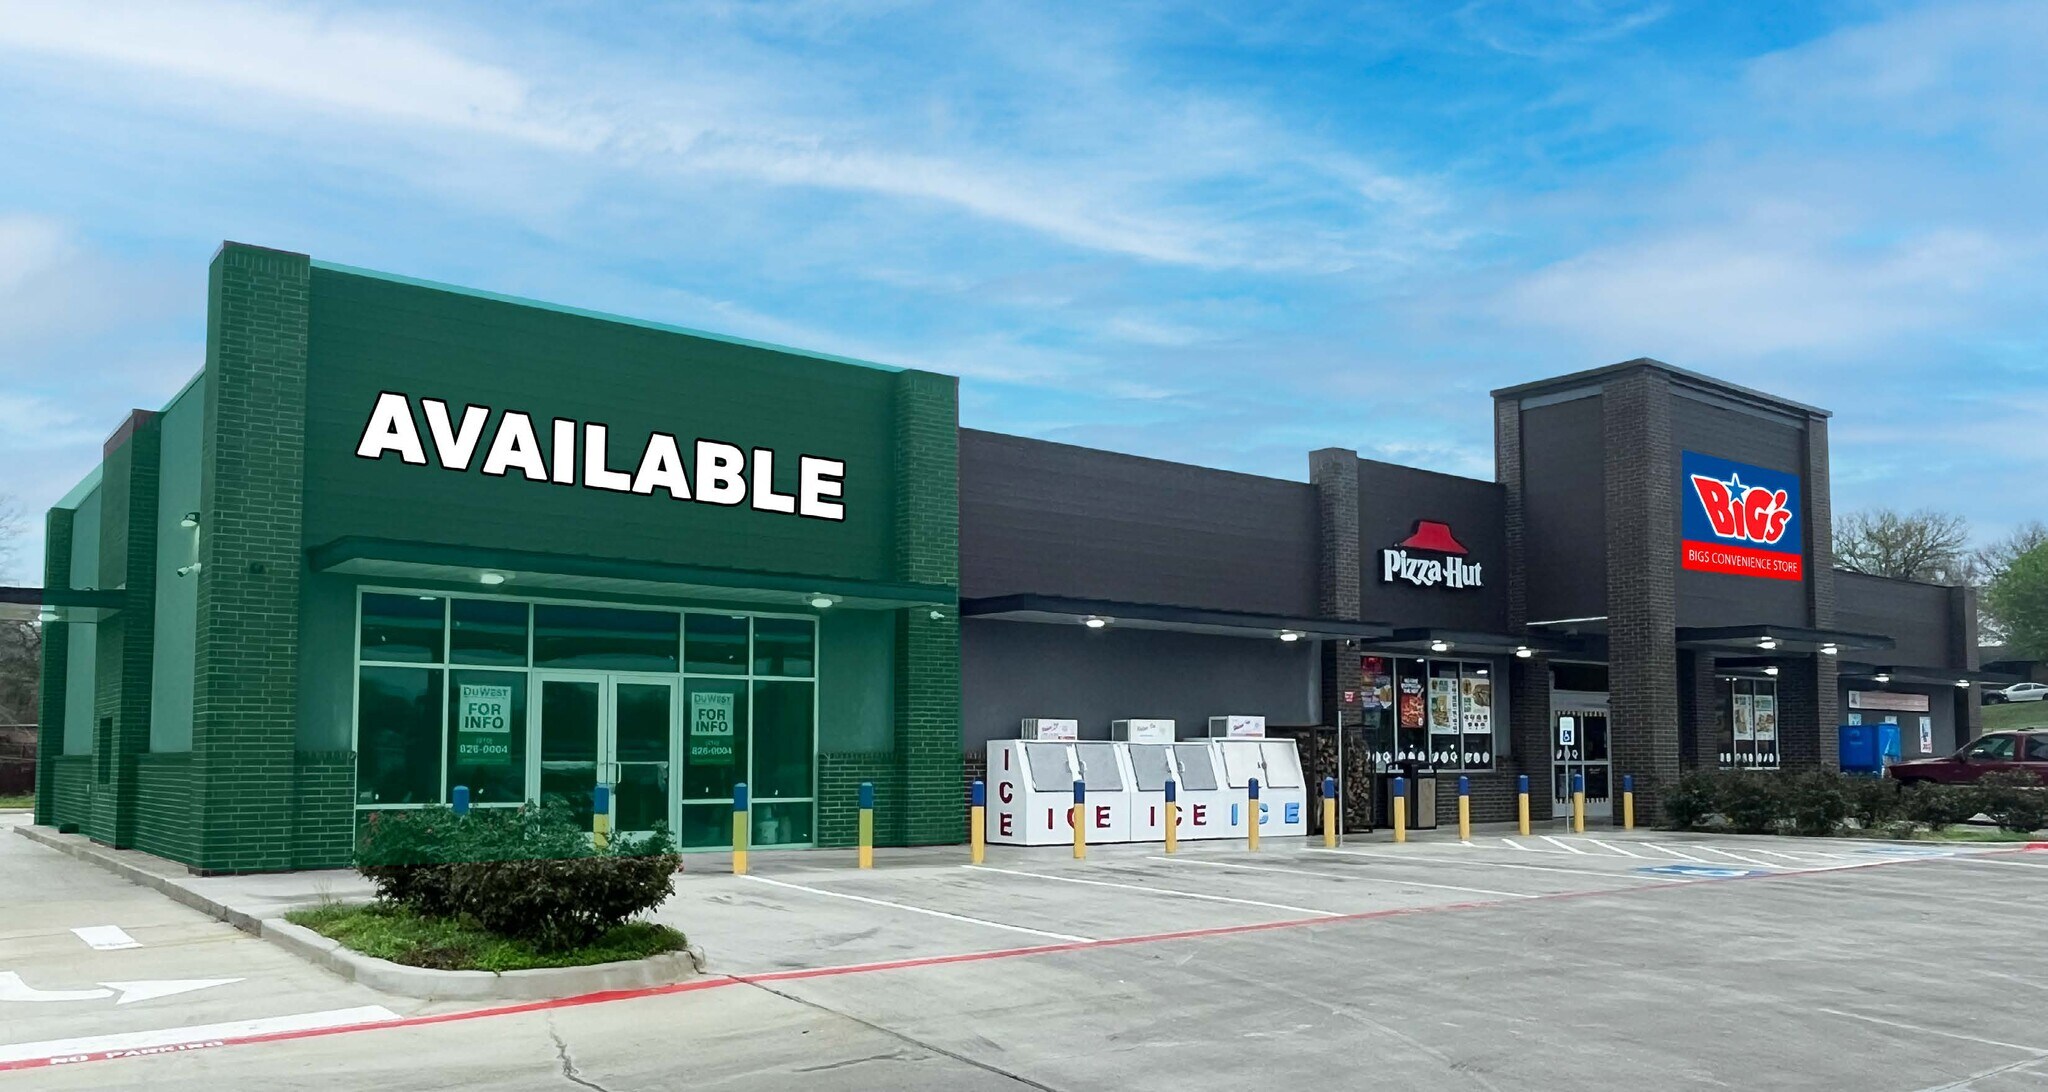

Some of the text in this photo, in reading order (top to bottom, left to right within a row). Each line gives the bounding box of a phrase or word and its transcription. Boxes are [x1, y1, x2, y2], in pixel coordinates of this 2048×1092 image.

[1688, 549, 1798, 573] BIGS CONVENIENCE STORE
[1384, 549, 1482, 588] Pizza Hut
[468, 702, 501, 716] FOR
[698, 708, 726, 721] FOR
[464, 716, 504, 729] INFO
[695, 721, 728, 732] INFO
[999, 748, 1013, 837] ICE
[50, 1055, 89, 1065] NO
